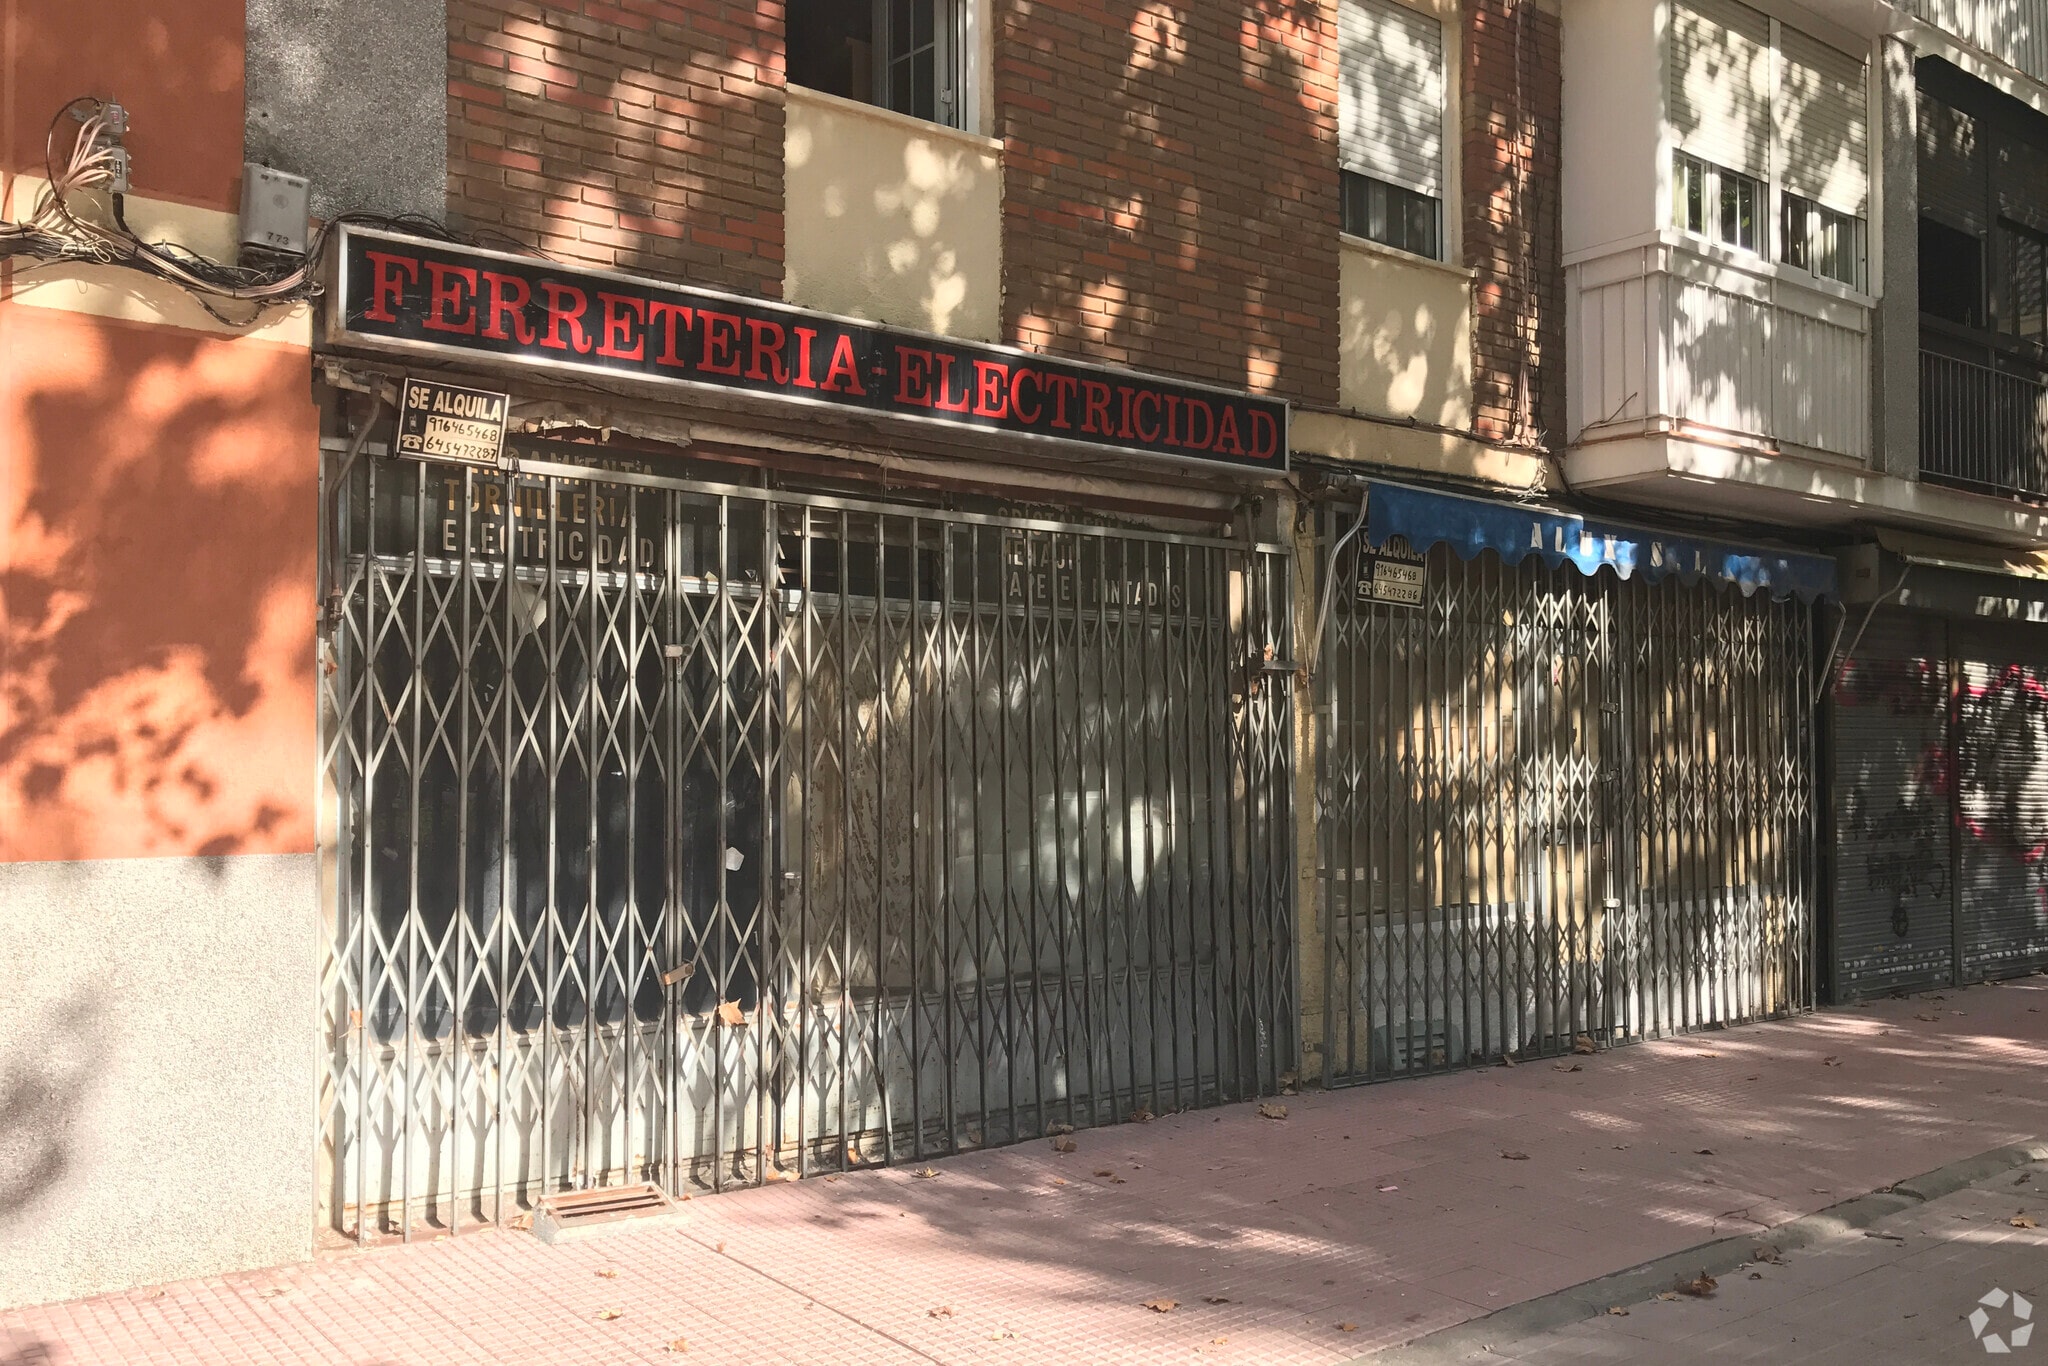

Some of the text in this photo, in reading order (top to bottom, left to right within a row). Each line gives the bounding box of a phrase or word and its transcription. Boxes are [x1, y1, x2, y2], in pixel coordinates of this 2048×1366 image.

[267, 231, 289, 245] 773
[408, 386, 502, 422] SE ALQUILA
